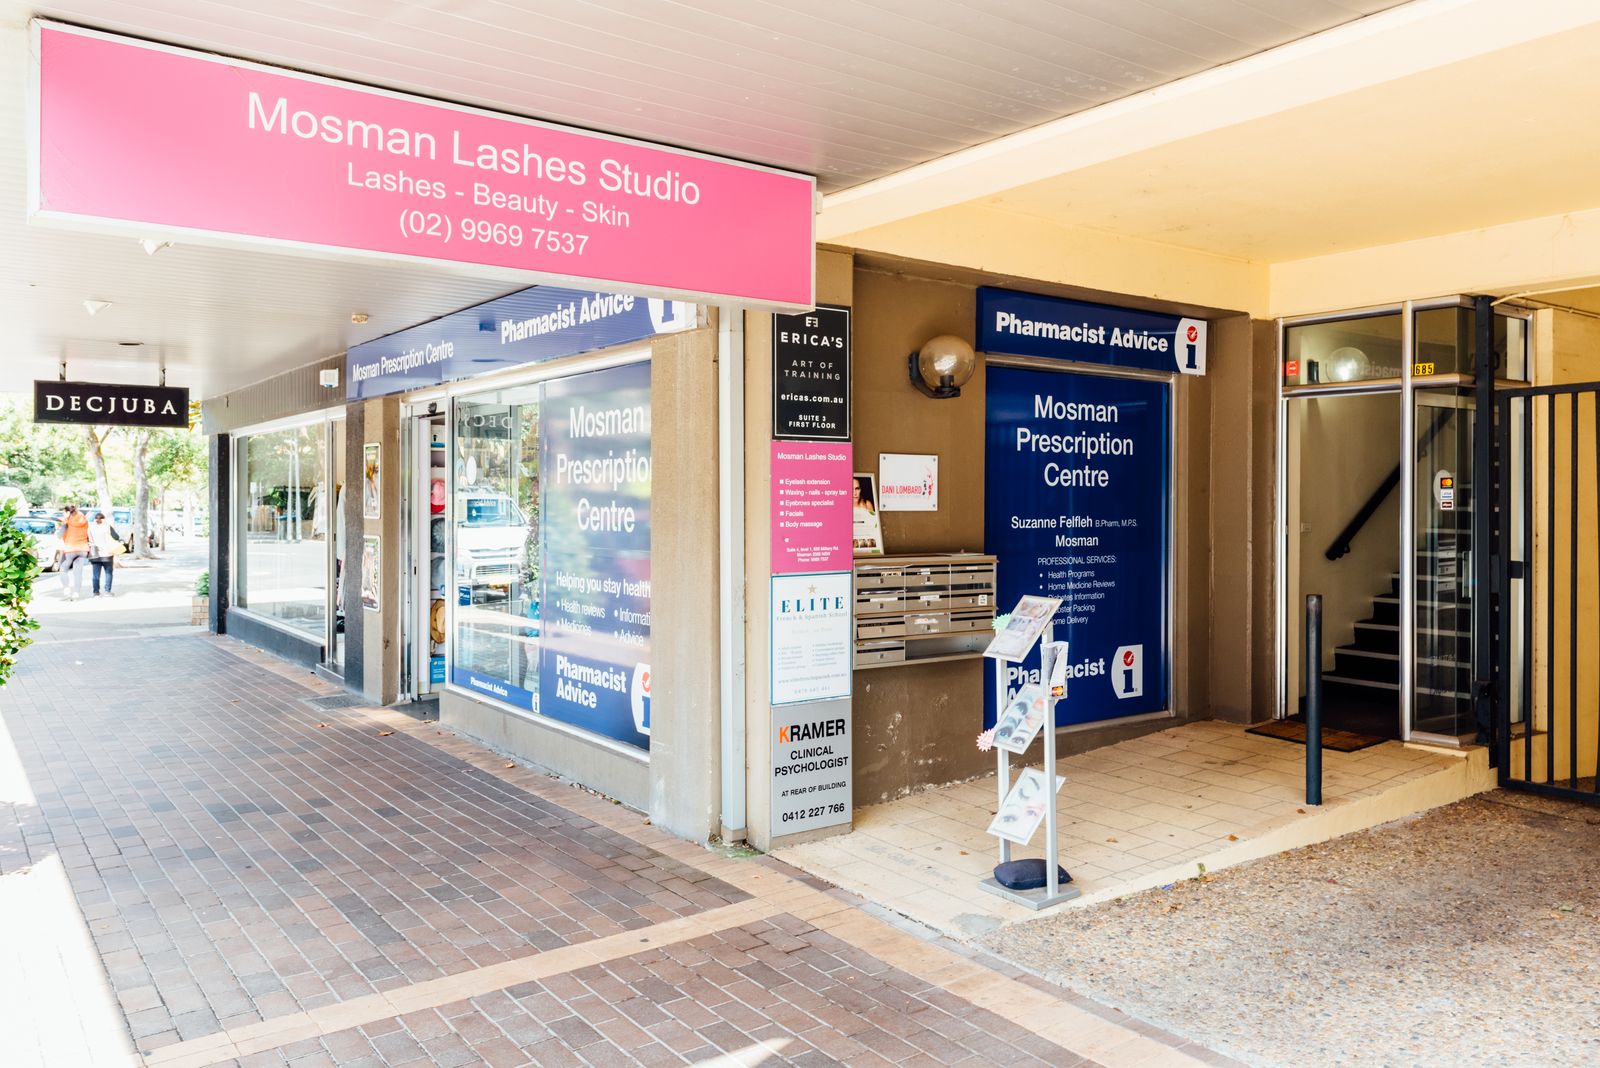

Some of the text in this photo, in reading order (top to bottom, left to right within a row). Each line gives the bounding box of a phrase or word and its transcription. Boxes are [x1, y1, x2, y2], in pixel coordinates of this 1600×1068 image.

[248, 91, 700, 205] Mosman Lashes Studio
[347, 161, 447, 199] Lashes
[473, 182, 558, 221] Beauty
[582, 201, 630, 228] Skin
[399, 209, 590, 256] (02) 9969 7537
[501, 292, 635, 345] Pharmacist Advice
[780, 331, 843, 349] ERICA'S
[995, 311, 1169, 352] Pharmacist Advice
[352, 339, 454, 382] Mosman Prescription Centre
[791, 359, 834, 369] ART OF
[784, 369, 841, 381] TRAINING
[1415, 365, 1433, 375] 685
[45, 394, 178, 416] DECJUBA
[780, 392, 844, 404] ericas.com.au
[1034, 394, 1119, 423] Mosman
[569, 405, 645, 439] Mosman
[788, 420, 836, 429] FIRST FLOOR
[798, 414, 820, 422] SUITE
[1015, 427, 1134, 459] Prescription
[777, 452, 847, 461] Mosman Lashes Studio
[785, 478, 805, 486] Eyelash
[1043, 462, 1110, 488] Centre
[785, 489, 805, 497] Waxing
[882, 485, 922, 495] DANI LOMBARD
[577, 498, 636, 533] Centre
[785, 511, 804, 519] Facials
[1011, 516, 1057, 530] Suzanne
[1059, 516, 1093, 529] Felfleh
[785, 521, 799, 529] Body
[1055, 535, 1100, 548] Mosman
[1037, 555, 1117, 566] PROFESSIONAL SERVICES:
[1047, 570, 1096, 579] Health Programs
[556, 571, 651, 599] Helping you stay health
[1047, 583, 1066, 591] Home
[1066, 582, 1093, 590] Medicine
[781, 597, 844, 613] ELITE
[1074, 592, 1105, 601] Information
[561, 598, 606, 619] Health reviews
[1072, 604, 1096, 613] Packing
[620, 608, 651, 627] Informati
[1052, 616, 1089, 626] ome Delivery
[620, 629, 644, 647] Advice
[556, 654, 627, 694] Pharmacist
[1007, 657, 1106, 686] Phaacist
[556, 677, 598, 709] Advice
[779, 719, 846, 744] KRAMER
[790, 745, 834, 760] CLINICAL
[774, 756, 849, 777] PSYCHOLOGIST
[790, 787, 807, 796] REAR
[818, 781, 847, 792] BUILDING
[782, 802, 846, 823] 0412 227 766
